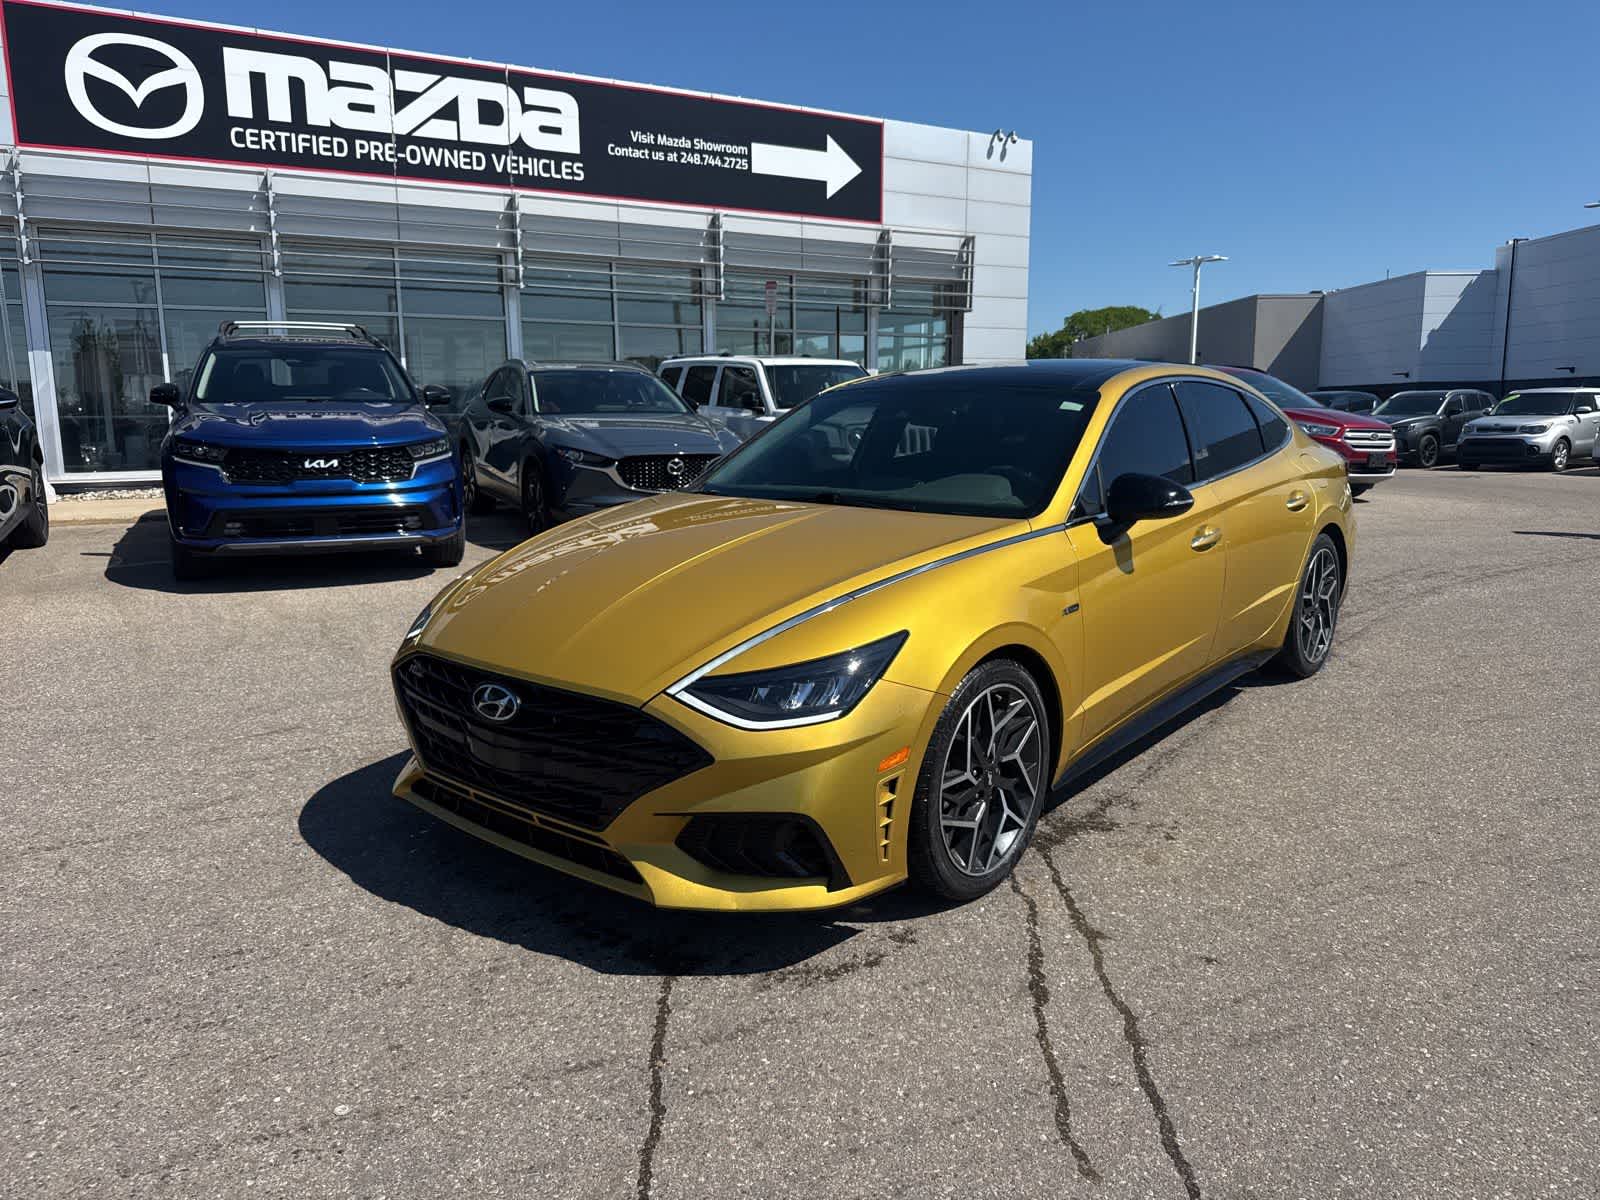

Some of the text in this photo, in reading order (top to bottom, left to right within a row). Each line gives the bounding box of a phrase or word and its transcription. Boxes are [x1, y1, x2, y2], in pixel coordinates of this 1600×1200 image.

[230, 126, 585, 181] CERTIFIED PRE-OWNED VEHICLES
[630, 130, 748, 155] Visit Mazda Showroom
[607, 143, 749, 170] Contact us at 248.744.2725
